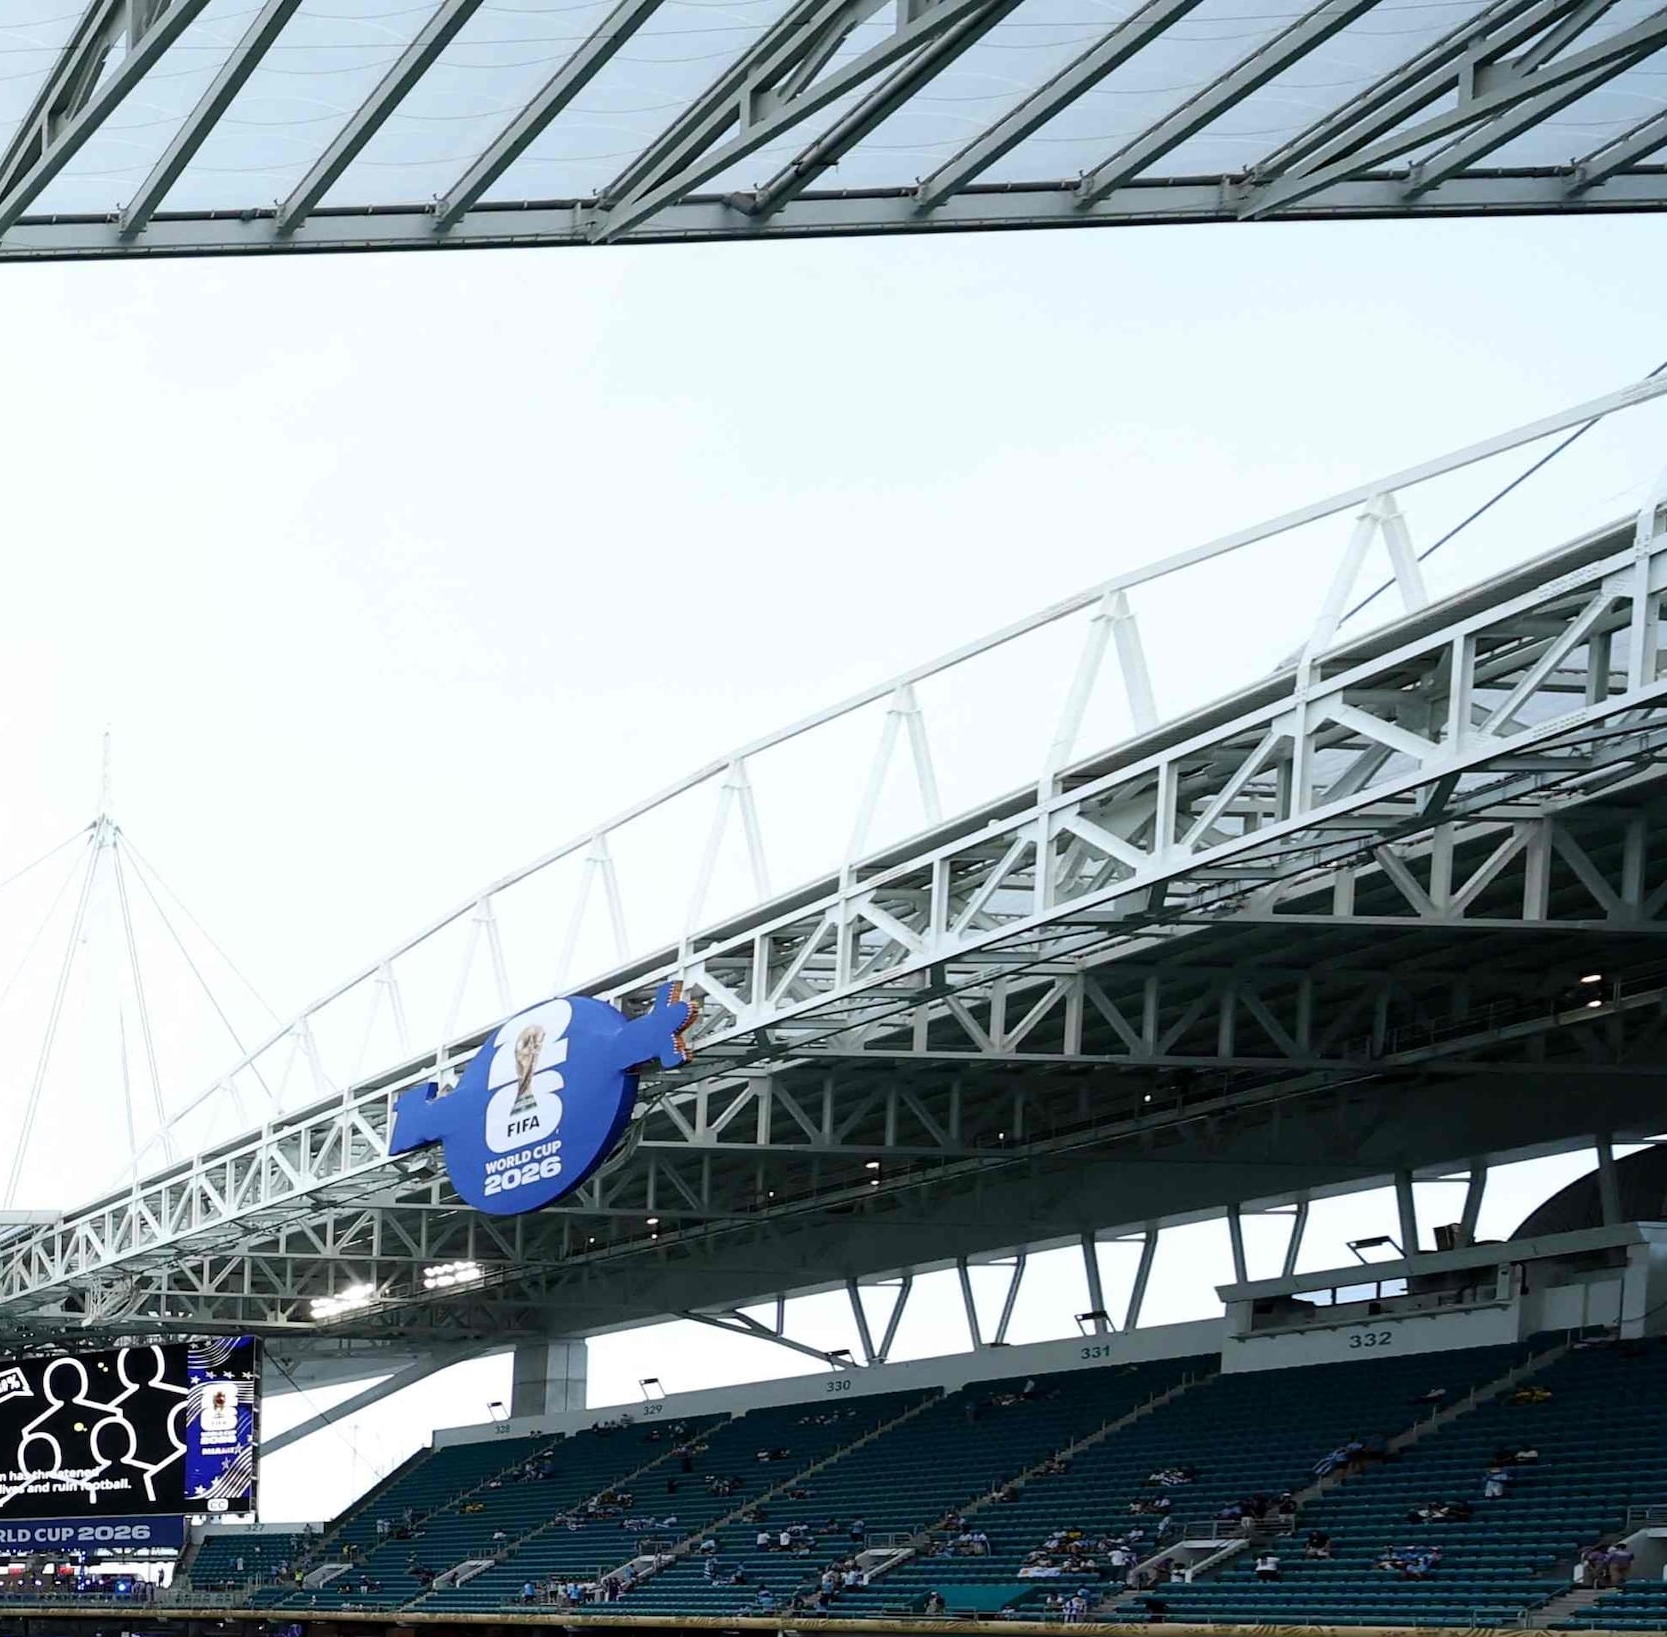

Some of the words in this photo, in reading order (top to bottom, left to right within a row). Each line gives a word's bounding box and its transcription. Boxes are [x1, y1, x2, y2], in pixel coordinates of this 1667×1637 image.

[507, 1116, 540, 1138] FIFA
[485, 1150, 533, 1175] WORLD
[533, 1140, 563, 1160] CUP
[483, 1156, 563, 1197] 2026
[1349, 1332, 1392, 1349] 332
[1080, 1346, 1110, 1360] 331
[826, 1380, 852, 1392] 330
[28, 1482, 49, 1494] and
[51, 1480, 78, 1492] ruin
[34, 1527, 74, 1542] CUP
[77, 1525, 151, 1541] 2026
